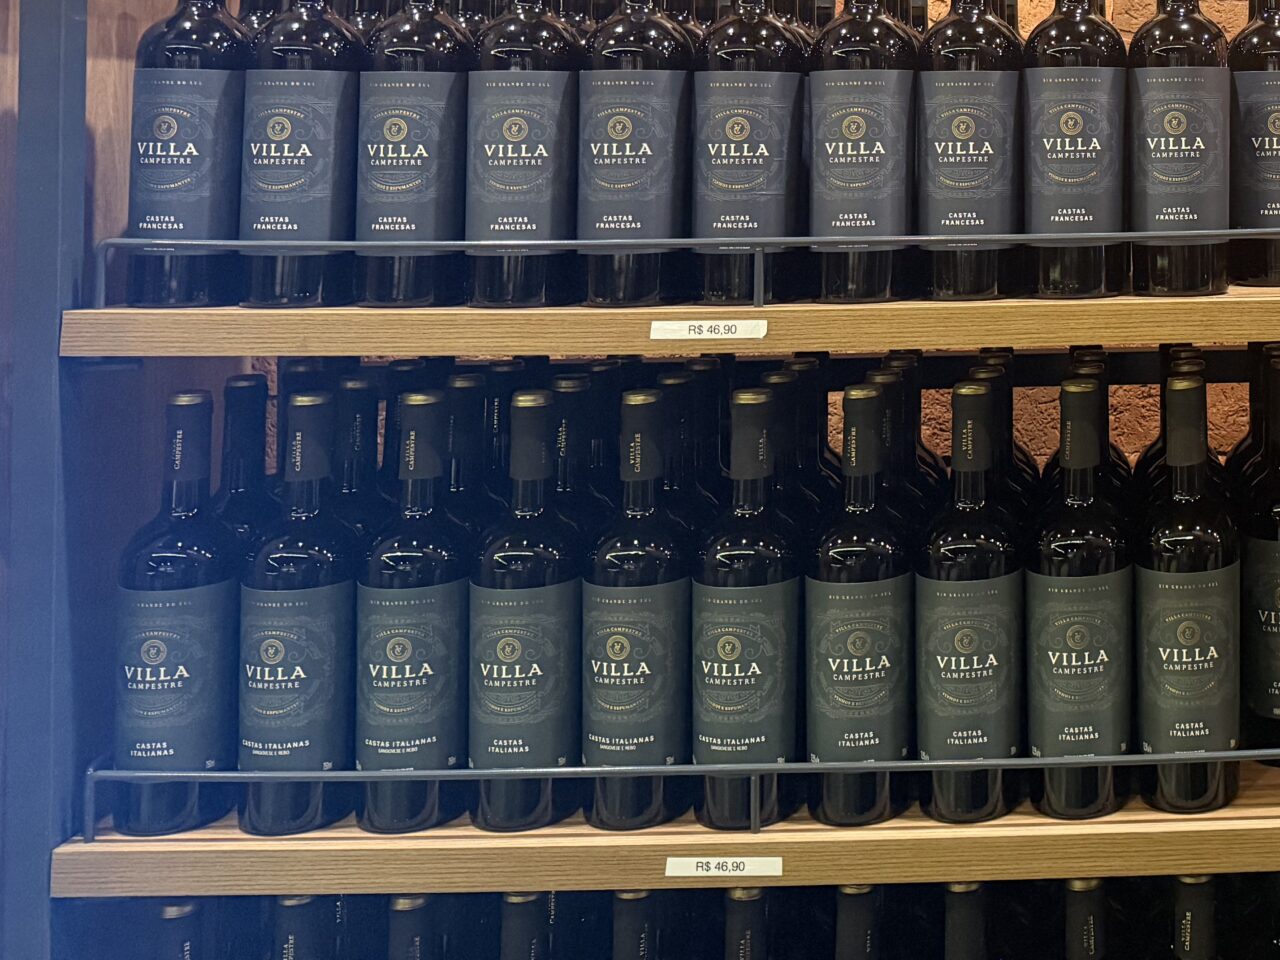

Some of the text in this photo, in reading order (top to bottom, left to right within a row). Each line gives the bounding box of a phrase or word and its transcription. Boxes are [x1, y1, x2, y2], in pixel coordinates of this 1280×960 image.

[138, 142, 199, 156] VILLA
[251, 143, 313, 157] VILLA
[591, 143, 652, 156] VILLA
[708, 144, 769, 156] VILLA
[825, 142, 885, 155] VILLA
[935, 142, 994, 155] VILLA
[1043, 138, 1101, 150] VILLA
[1147, 138, 1205, 150] VILLA
[368, 145, 428, 158] VILLA
[484, 144, 548, 157] VILLA
[688, 324, 737, 335] R$ 46,90
[1048, 650, 1109, 665] VILLA
[1158, 646, 1218, 661] VILLA
[828, 656, 890, 672] VILLA
[937, 654, 998, 669] VILLA
[1163, 662, 1214, 671] CAMPESTRE
[125, 666, 189, 681] VILLA
[246, 665, 306, 680] VILLA
[369, 663, 433, 678] VILLA
[481, 663, 543, 678] VILLA
[591, 660, 651, 676] VILLA
[702, 661, 762, 676] VILLA
[941, 670, 993, 678] CAMPESTRE
[1053, 665, 1104, 674] CAMPESTRE
[595, 677, 645, 685] CAMPESTRE
[705, 677, 755, 686] CAMPESTRE
[833, 671, 886, 681] CAMPESTRE
[128, 681, 182, 690] CAMPESTRE
[248, 681, 300, 689] CAMPESTRE
[373, 679, 427, 687] CAMPESTRE
[484, 679, 536, 687] CAMPESTRE
[242, 740, 310, 749] CASTAS ITALIANAS
[365, 736, 437, 747] CASTAS ITALIANAS
[589, 734, 654, 744] CASTAS ITALIANAS
[699, 735, 765, 744] CASTAS ITALIANAS
[838, 738, 879, 747] ITALIANAS
[131, 749, 174, 757] ITALIANAS
[696, 861, 745, 872] R$ 46,90
